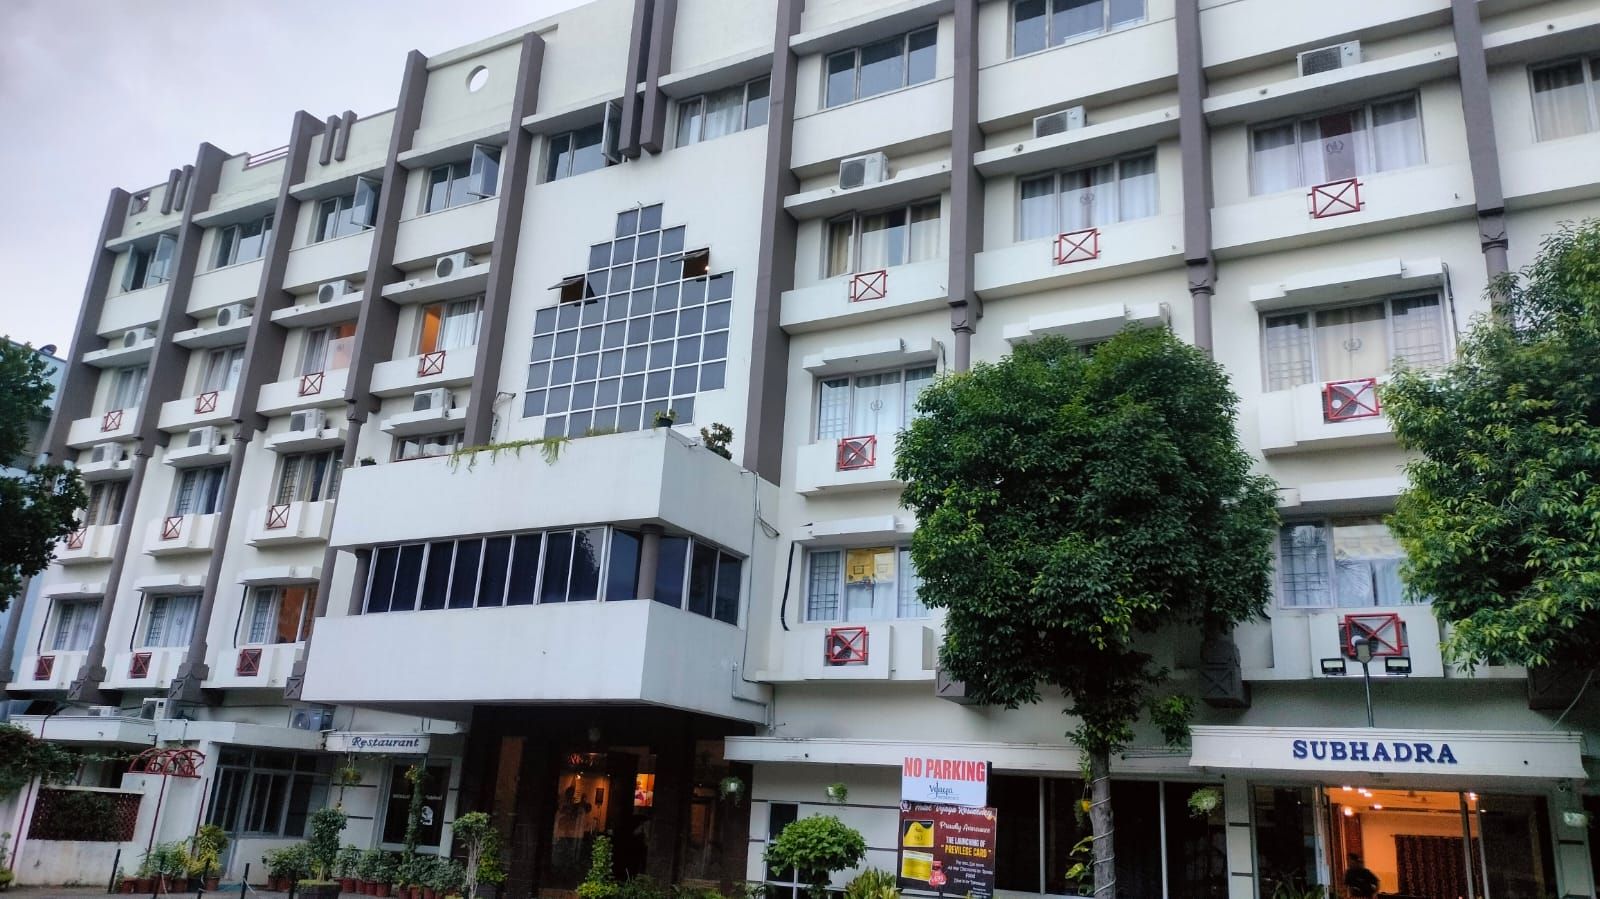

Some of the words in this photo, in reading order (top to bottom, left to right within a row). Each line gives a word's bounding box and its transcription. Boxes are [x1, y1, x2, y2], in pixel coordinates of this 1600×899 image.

[352, 736, 419, 748] Restaurant
[1292, 739, 1458, 764] SUBHADRA
[904, 757, 922, 778] NO
[926, 758, 986, 782] PARKING
[939, 821, 962, 833] Proudly
[946, 836, 954, 844] THE
[954, 837, 979, 847] LAUNCHING
[980, 839, 986, 848] OF
[973, 847, 988, 858] CARD
